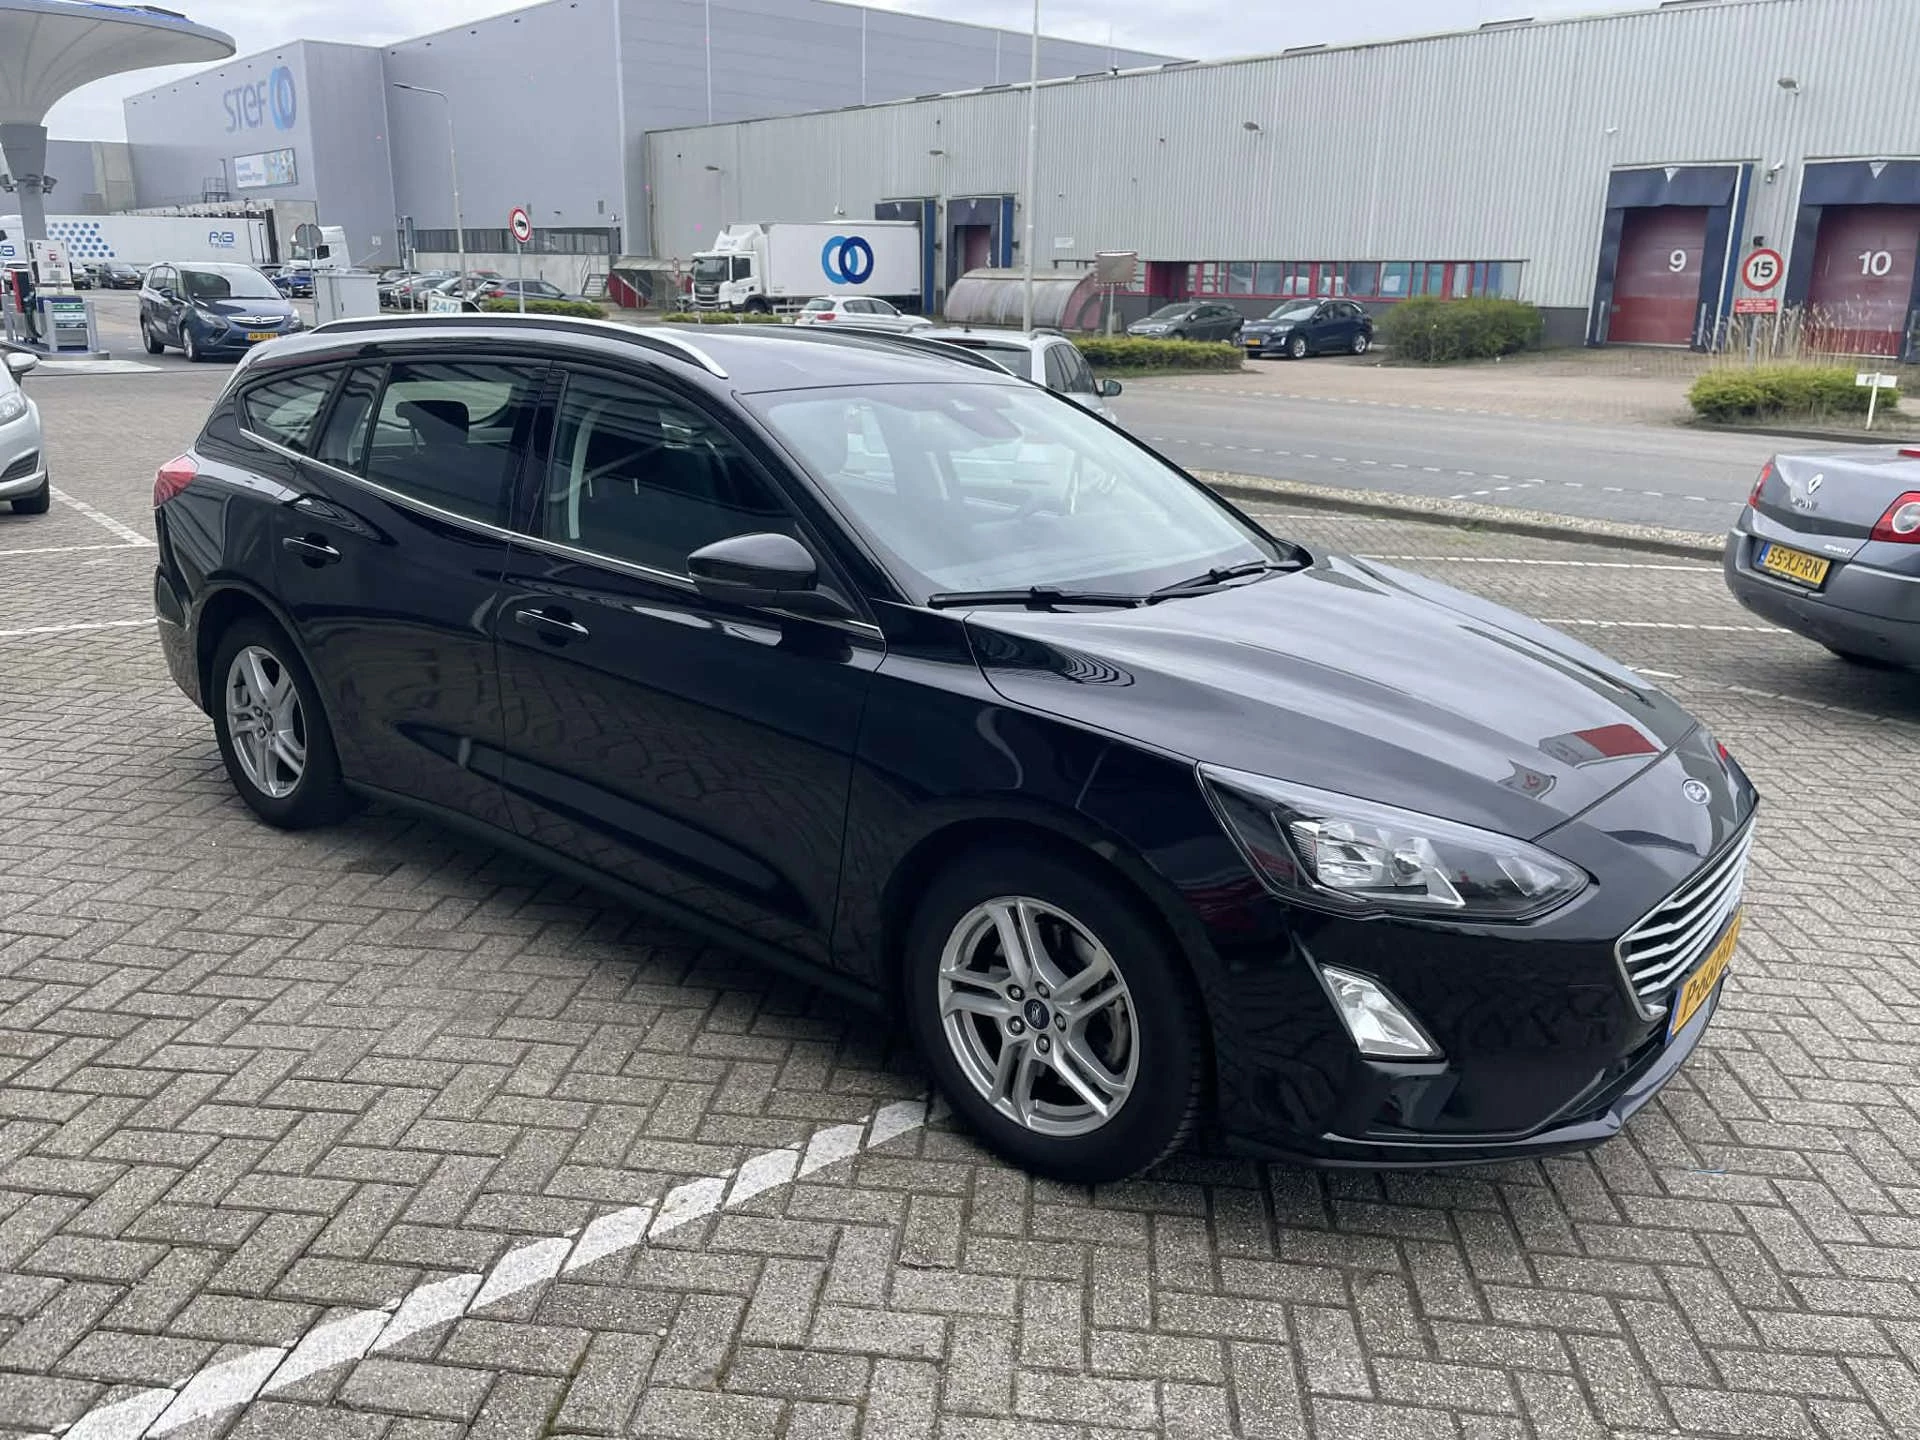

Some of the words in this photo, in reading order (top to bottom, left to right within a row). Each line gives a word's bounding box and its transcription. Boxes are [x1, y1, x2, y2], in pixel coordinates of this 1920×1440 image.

[1668, 249, 1686, 272] 9
[1753, 261, 1773, 278] 15
[1858, 251, 1892, 276] 10
[432, 300, 458, 313] 24/7
[1767, 547, 1823, 580] 55-XJ-RN
